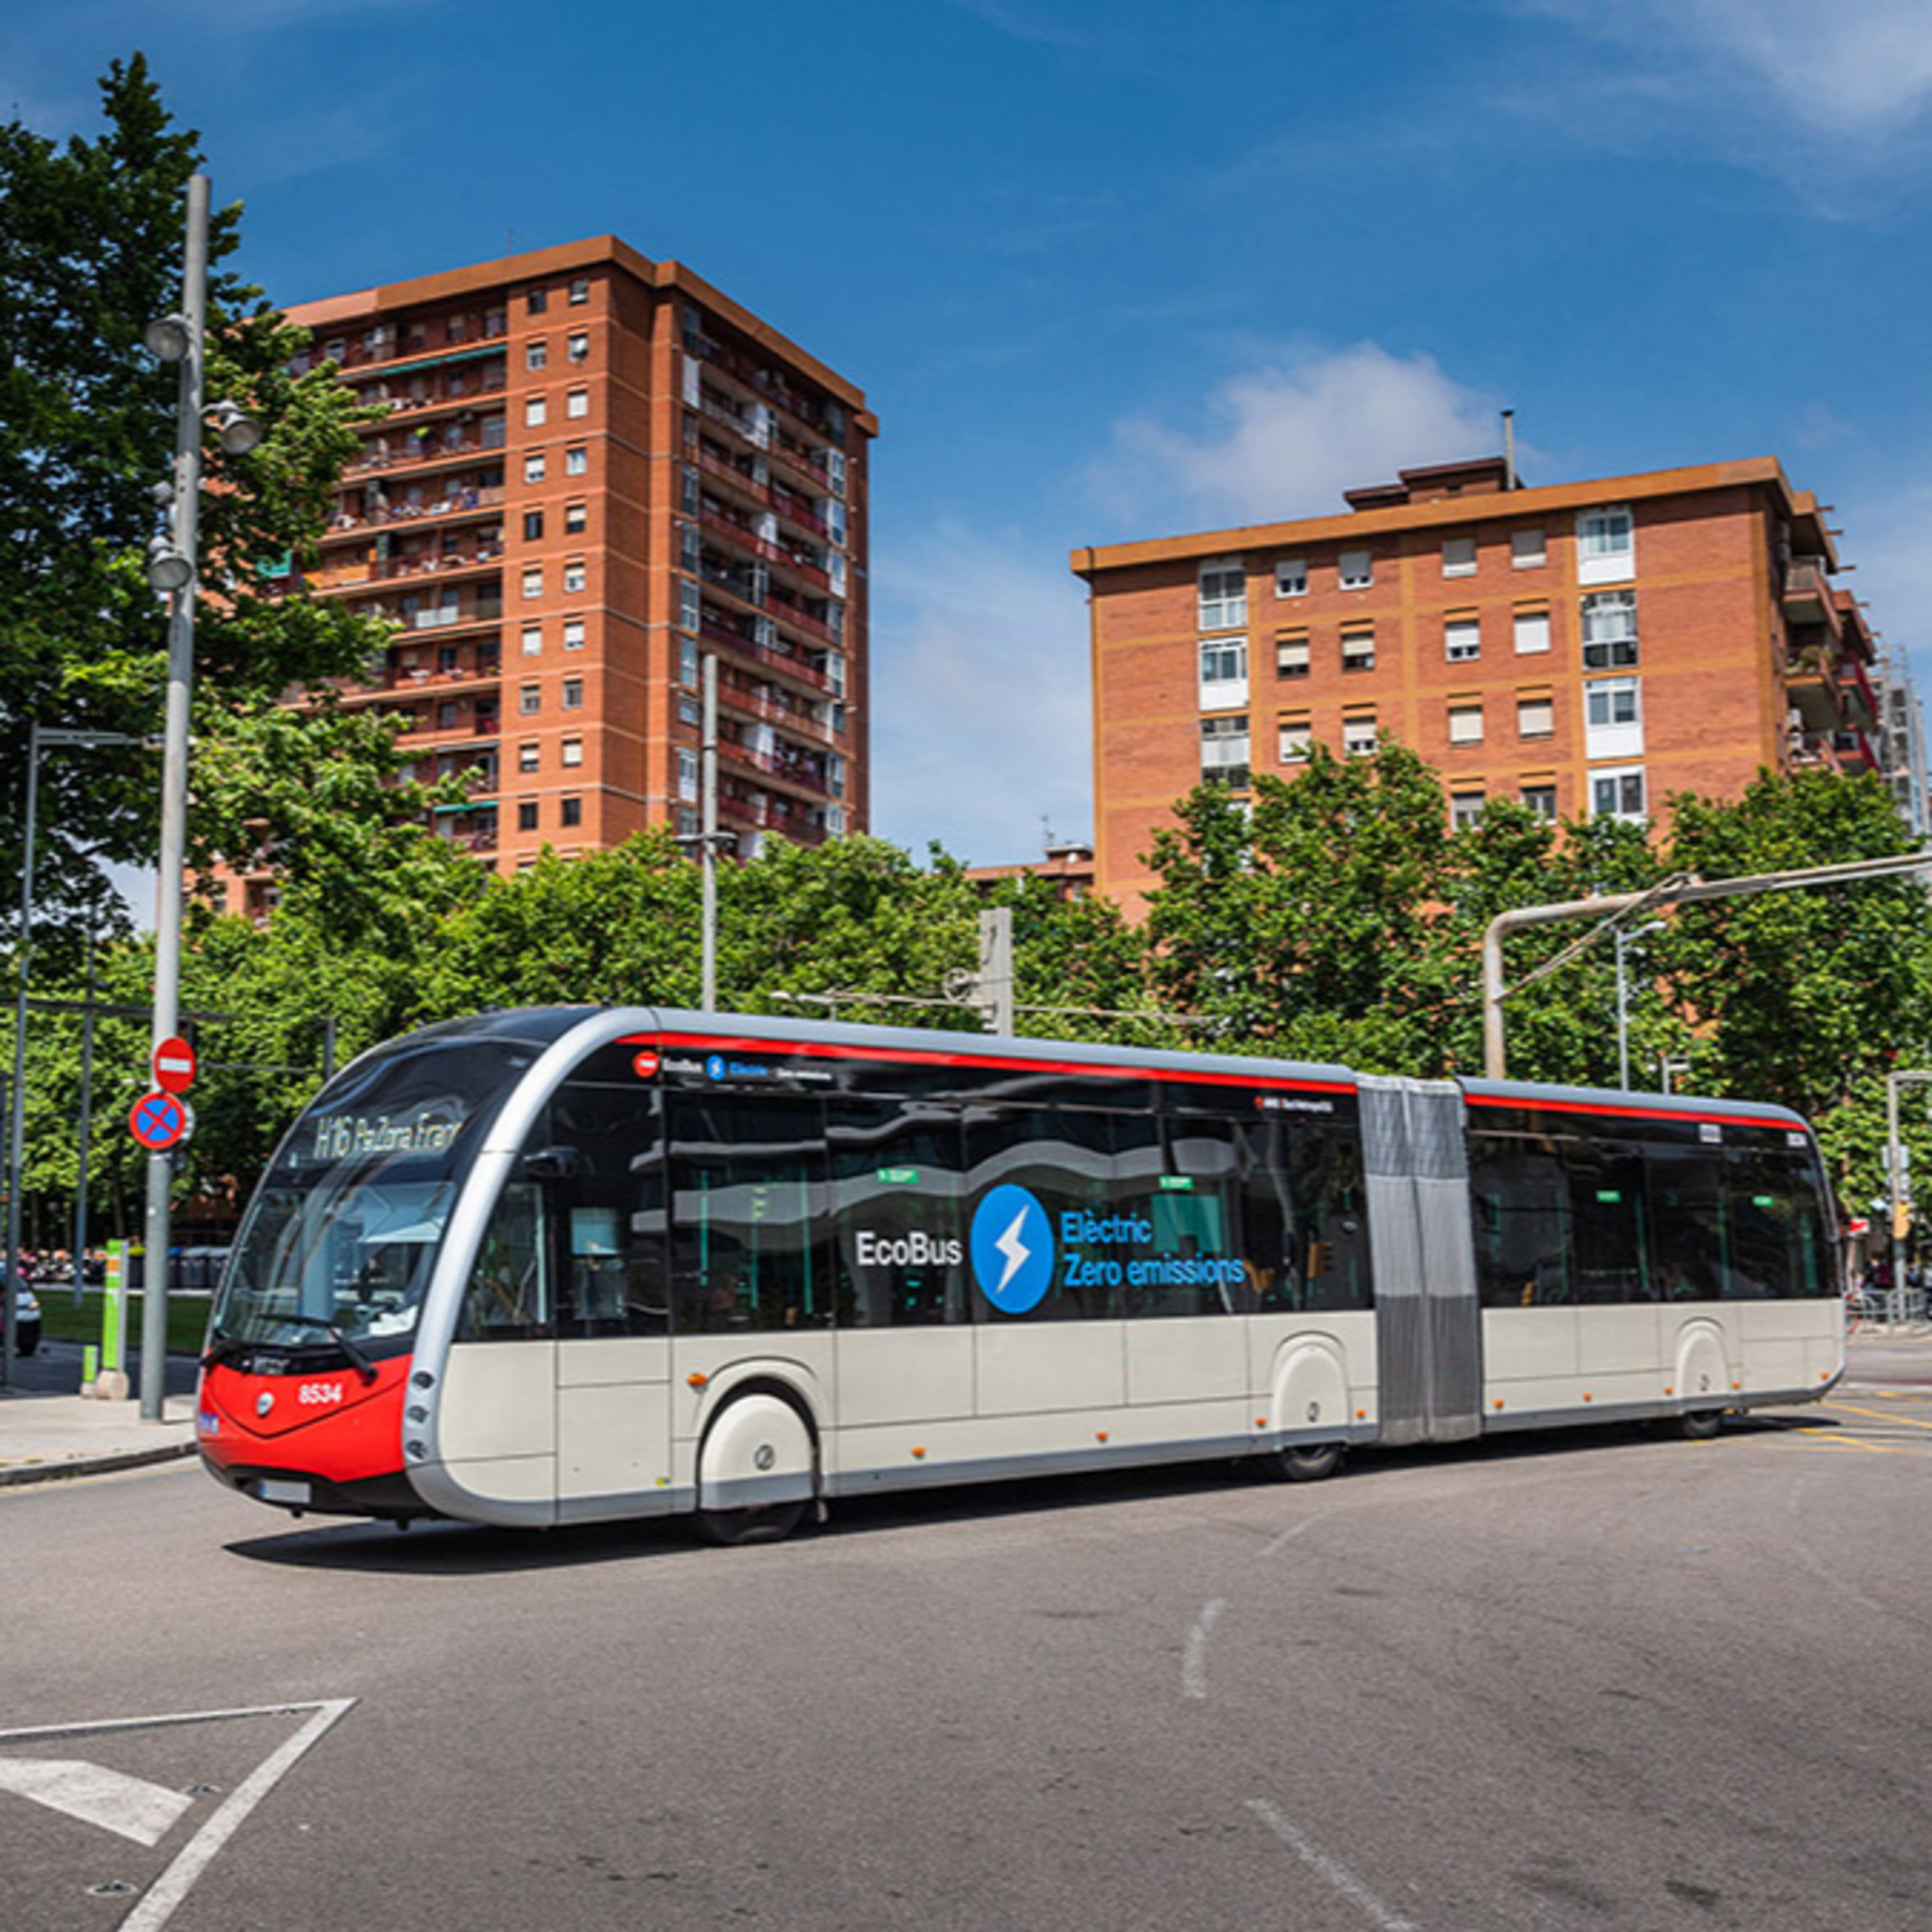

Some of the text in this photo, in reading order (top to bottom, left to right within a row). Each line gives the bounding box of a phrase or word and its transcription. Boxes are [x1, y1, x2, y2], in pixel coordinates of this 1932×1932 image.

[1059, 1209, 1153, 1244] Elèctric
[856, 1231, 963, 1265] EcoBus
[1063, 1252, 1246, 1286] Zero emissions
[298, 1383, 343, 1405] 8534
